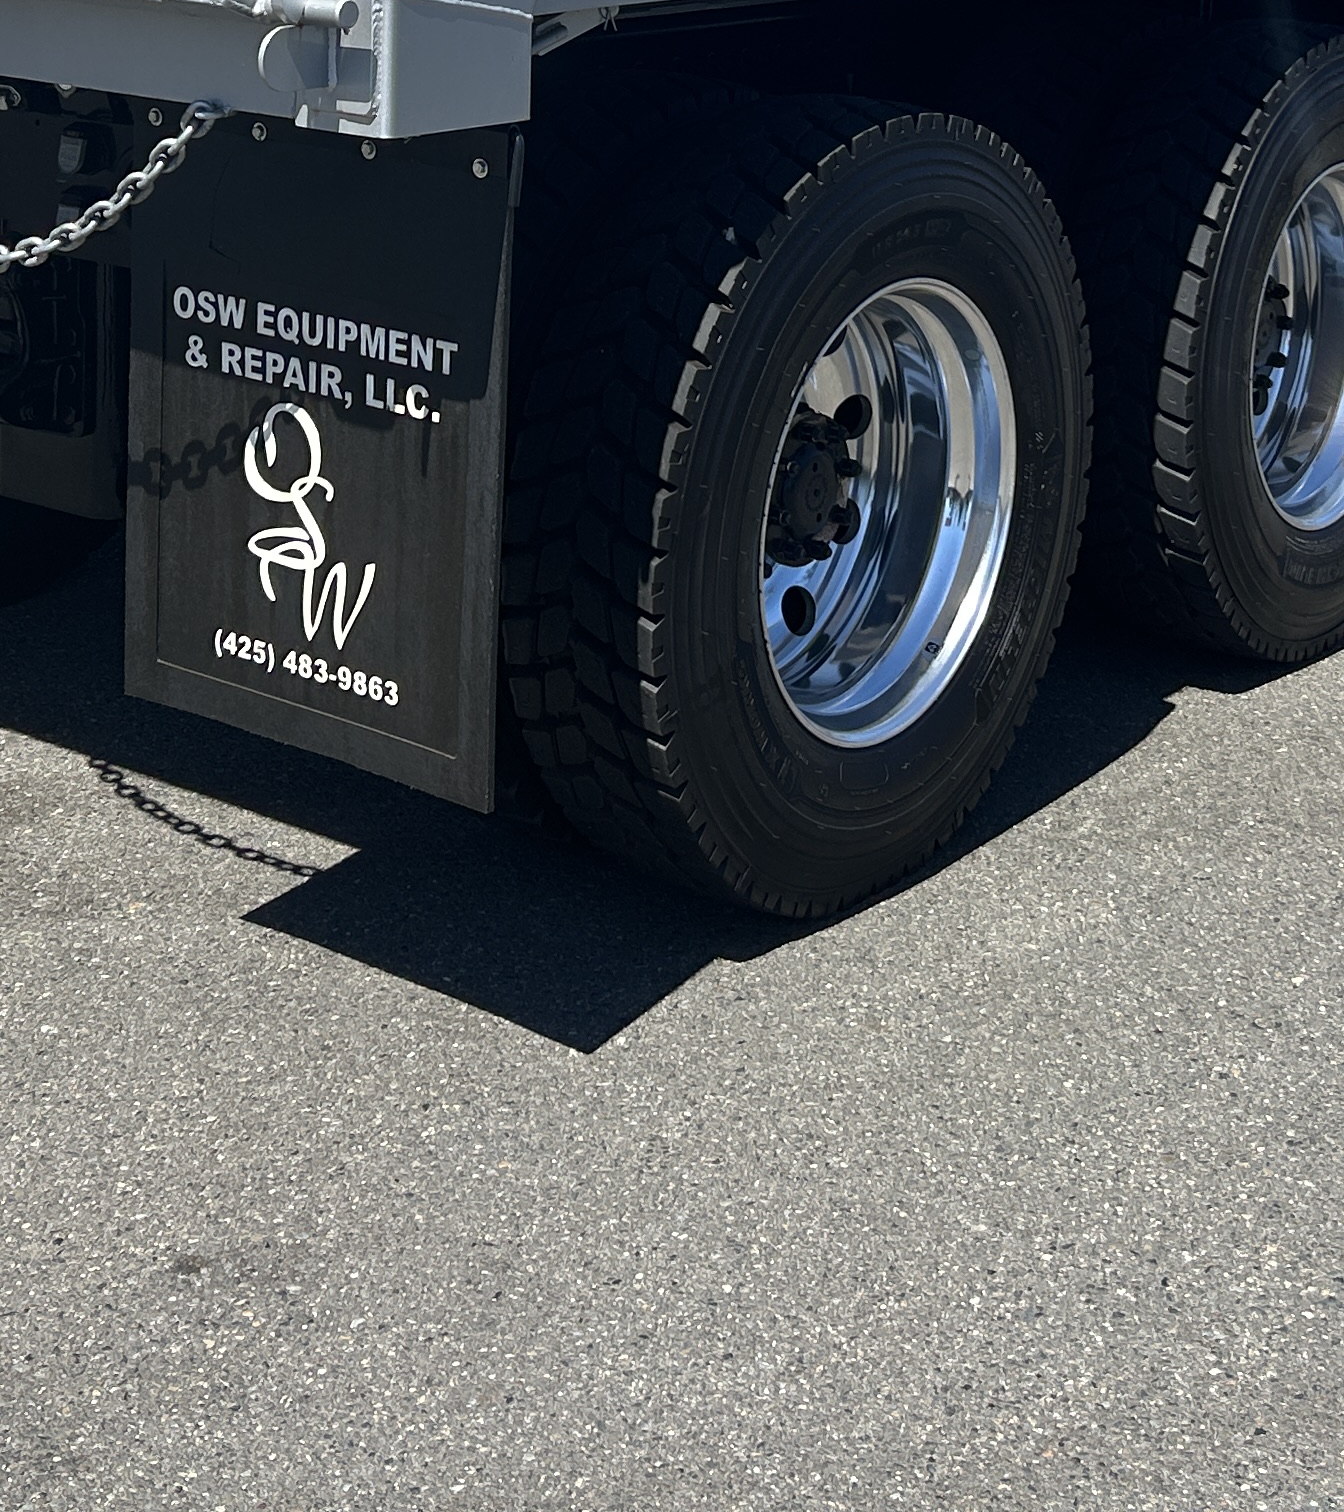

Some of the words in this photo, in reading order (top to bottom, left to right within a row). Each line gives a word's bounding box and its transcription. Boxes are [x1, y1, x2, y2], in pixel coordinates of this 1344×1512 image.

[173, 285, 247, 330] OSW
[256, 301, 459, 376] EQUIPMENT
[184, 334, 209, 369] &
[220, 341, 353, 410] REPAIR,
[365, 373, 441, 424] LLC.
[214, 628, 276, 675] (425)
[282, 650, 400, 708] 483-9863
